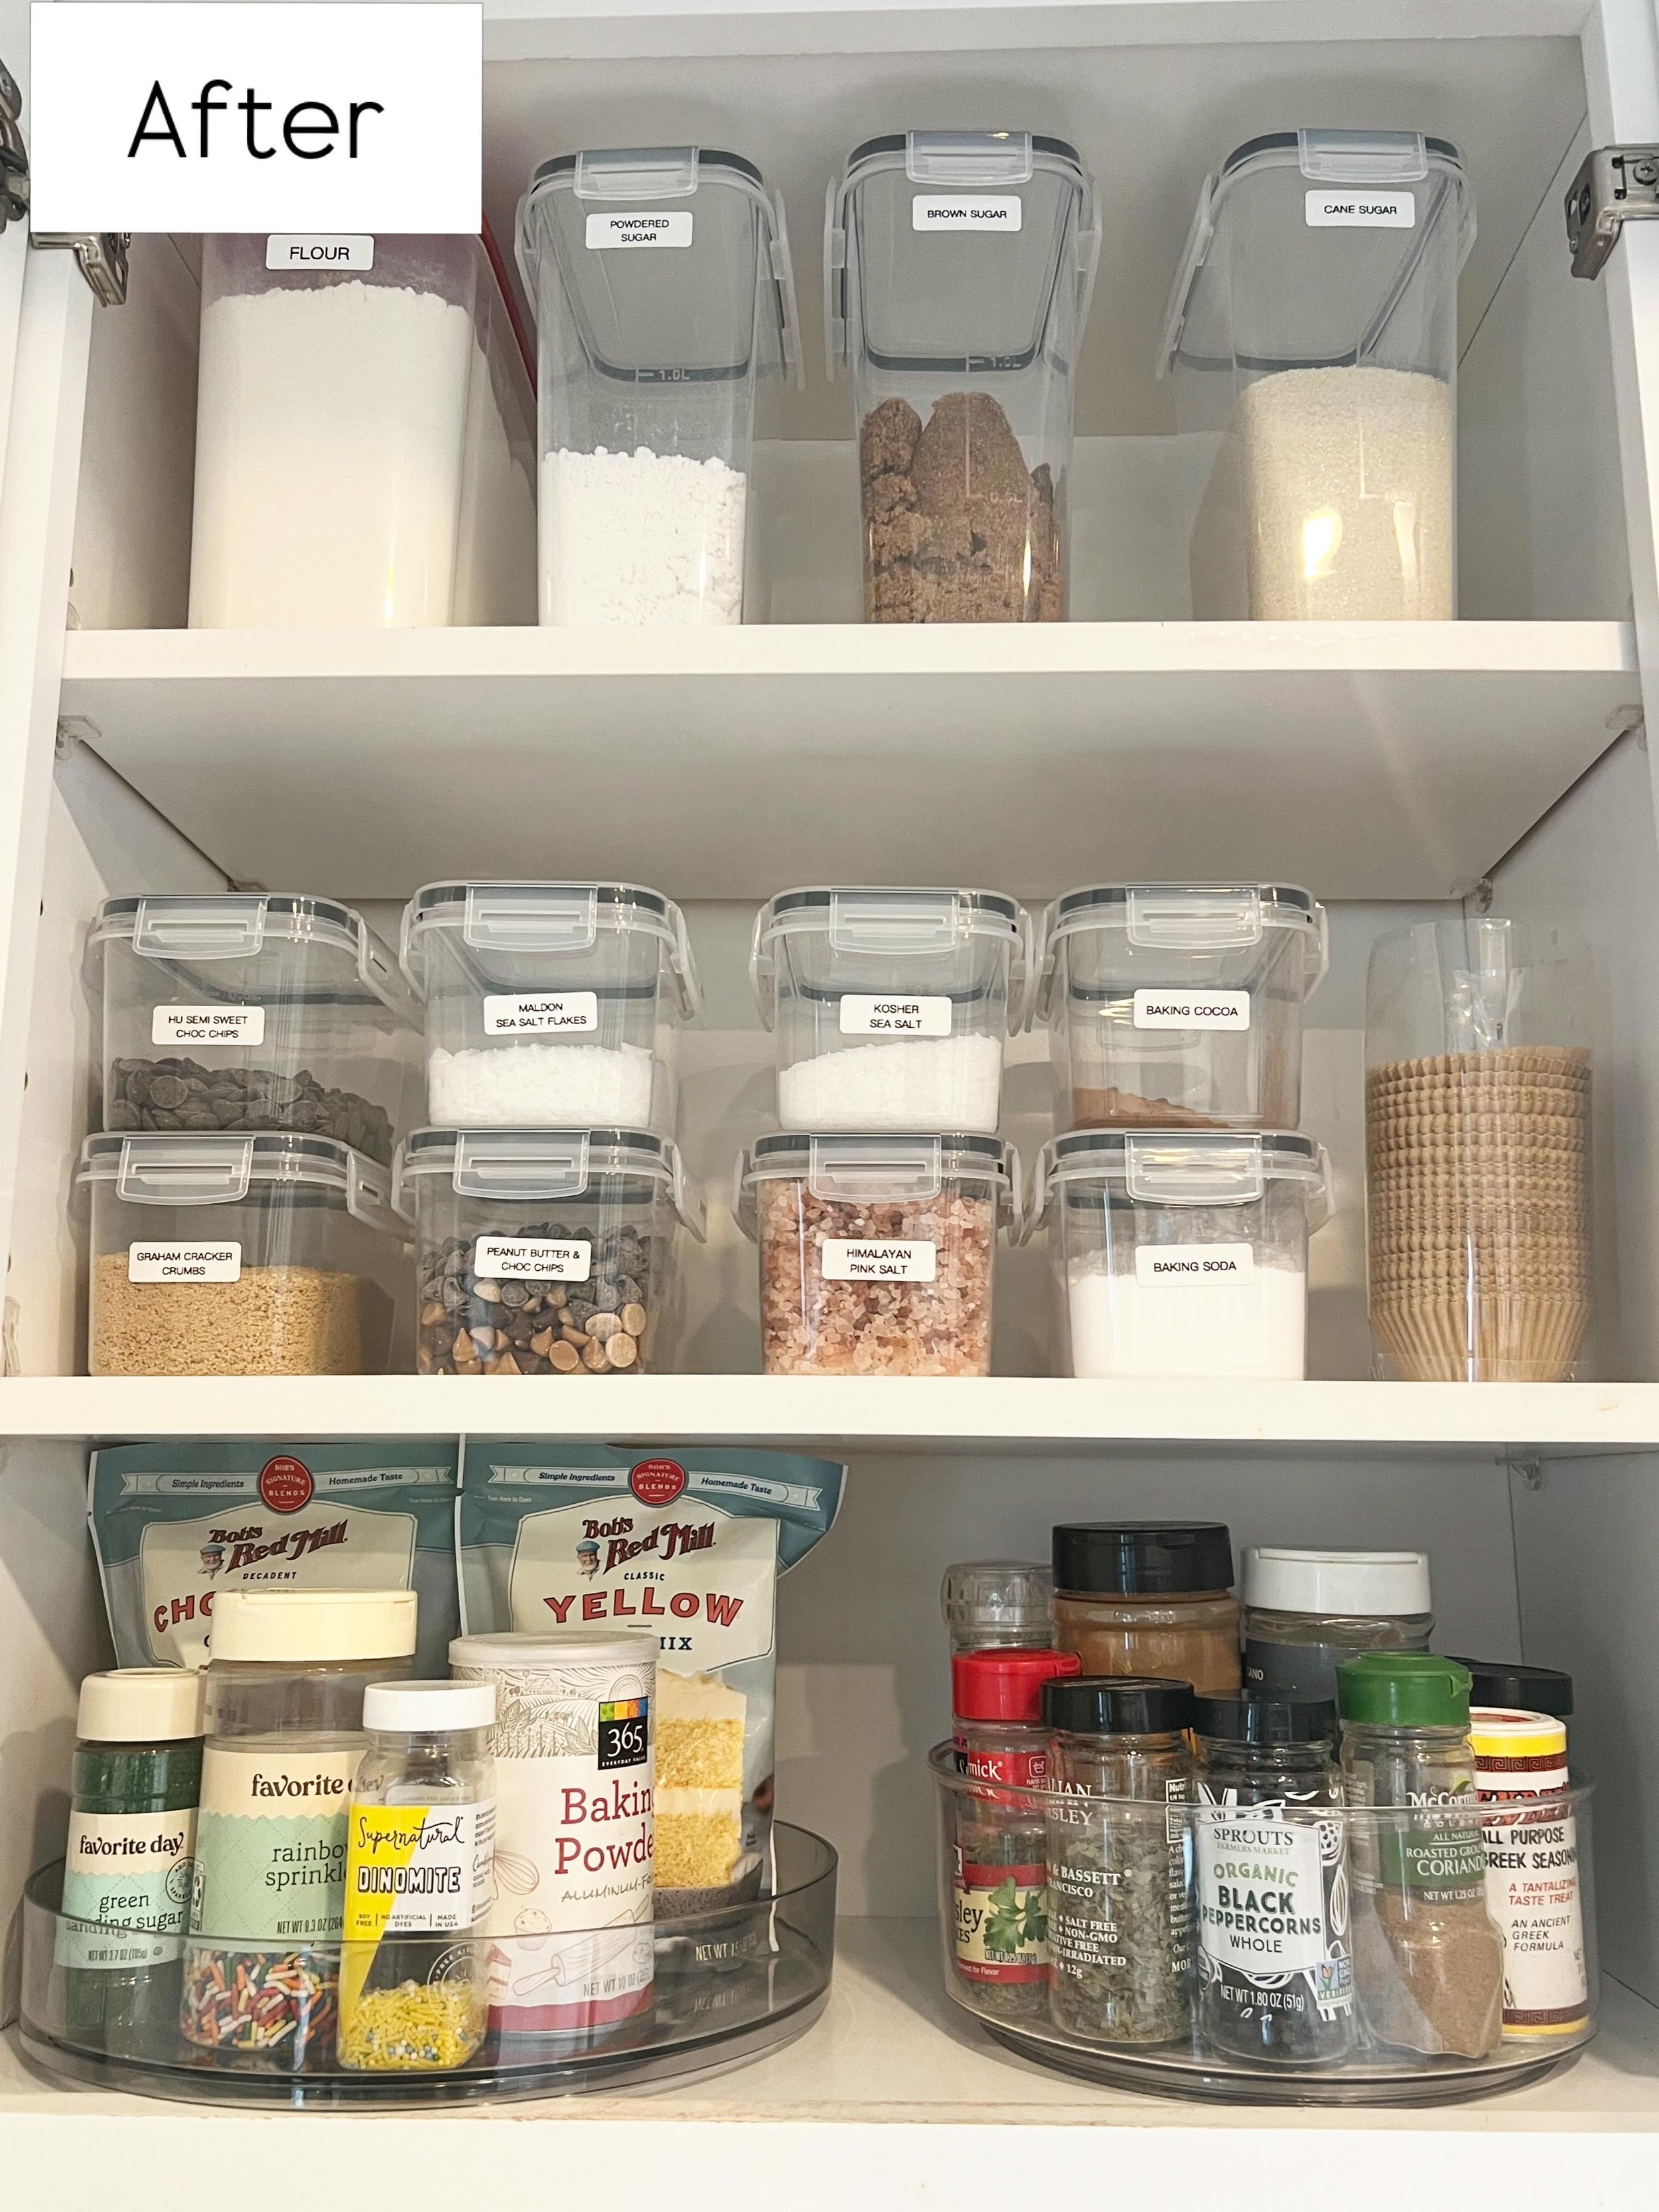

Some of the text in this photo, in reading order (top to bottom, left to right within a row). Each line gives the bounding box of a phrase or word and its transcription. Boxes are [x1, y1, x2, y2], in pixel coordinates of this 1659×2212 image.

[927, 210, 1007, 219] BROWN SUGAR
[1324, 204, 1398, 215] CANE SUGAR
[610, 220, 670, 229] POWDERED
[620, 233, 657, 242] SUGAR
[289, 246, 350, 260] FLOUR
[518, 1003, 563, 1013] MALDON
[873, 1003, 919, 1014] KOSHER
[1146, 1005, 1238, 1017] BAKING COCOA
[168, 1015, 249, 1025] HU SEMI SWEET
[496, 1015, 587, 1028] SEA SALT FLAKES
[869, 1019, 922, 1029] SEA SALT
[176, 1029, 239, 1039] CHOC CHIPS
[137, 1252, 233, 1262] GRAHAM CRACKER
[486, 1247, 580, 1260] PEANUT BUTTER &
[846, 1248, 912, 1260] HIMALAYAN
[162, 1266, 206, 1276] CRUMBS
[501, 1262, 564, 1273] CHOC CHIPS
[850, 1264, 908, 1275] PINK SALT
[1153, 1261, 1237, 1273] BAKING SODA
[265, 1474, 307, 1486] SIGNATURE
[329, 1474, 378, 1485] Homemade
[538, 1472, 616, 1482] Simple Ingredients
[636, 1471, 680, 1481] SIGNATURE
[171, 1479, 244, 1490] Simple Ingredients
[701, 1477, 772, 1495] Homemade Taste
[208, 1526, 263, 1544] Bob's
[582, 1517, 634, 1539] Bob's
[225, 1533, 290, 1574] Red
[603, 1526, 660, 1575] Red
[624, 1572, 666, 1581] CLASSIC
[543, 1587, 744, 1627] YELLOW
[660, 1637, 693, 1651] IX
[607, 1722, 643, 1757] 365
[601, 1758, 631, 1767] EVERYDAY
[251, 1774, 343, 1797] favorite
[561, 1779, 655, 1824] Bakin
[358, 1816, 465, 1854] Supernatural
[1214, 1828, 1293, 1846] SPROUTS
[1433, 1833, 1449, 1842] ALL
[1510, 1826, 1565, 1845] PURPOSE
[80, 1832, 184, 1856] favorite day
[555, 1822, 654, 1874] Powde
[1216, 1842, 1252, 1853] FARMERS
[1406, 1848, 1457, 1858] ROASTED
[265, 1862, 346, 1891] sprinkl
[358, 1866, 461, 1893] DINOMITE
[1060, 1866, 1121, 1885] BASSETT
[1213, 1862, 1298, 1887] ORGANIC
[1508, 1883, 1517, 1892] A
[1218, 1885, 1295, 1915] BLACK
[1423, 1891, 1439, 1901] NET
[1441, 1890, 1453, 1900] WT
[1508, 1891, 1573, 1905] TASTE TREAT
[99, 1895, 149, 1913] green
[136, 1911, 184, 1931] sugar
[277, 1921, 290, 1934] NET
[292, 1920, 303, 1933] WT
[317, 1918, 327, 1931] OZ
[1065, 1915, 1088, 1929] SALT
[1090, 1920, 1118, 1932] FREE
[1202, 1904, 1321, 1935] PEPPERCORNS
[1512, 1915, 1571, 1928] AN ANCIENT
[1064, 1926, 1118, 1943] NON-GMO
[1512, 1930, 1550, 1940] GREEK
[1074, 1939, 1099, 1953] FREE
[1230, 1935, 1283, 1953] WHOLE
[1514, 1941, 1564, 1952] FORMULA
[696, 1944, 712, 1961] NET
[713, 1943, 728, 1958] WT
[1066, 1964, 1083, 1979] 12g
[583, 1982, 600, 1996] NET
[603, 1979, 616, 1993] WT
[618, 1976, 626, 1990] 10
[1220, 1984, 1305, 2012] NET WT 1.80 OZ (51g)
